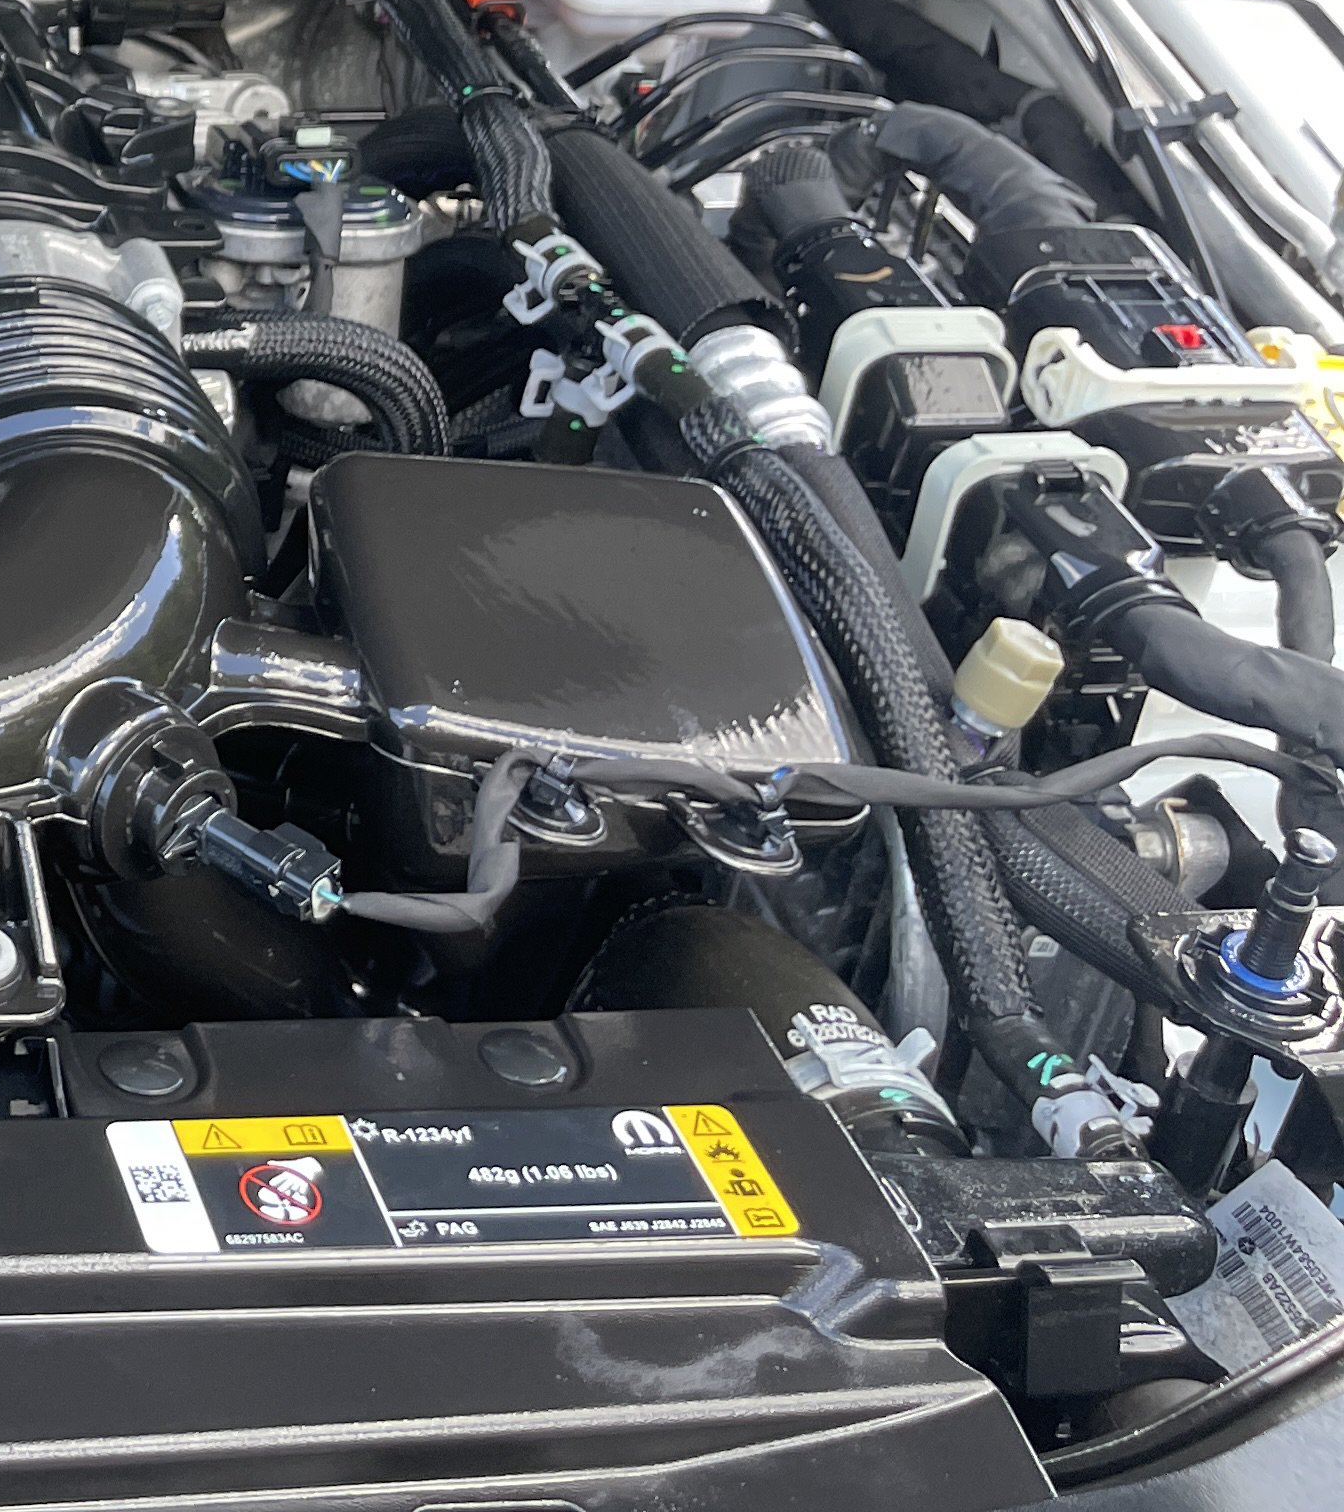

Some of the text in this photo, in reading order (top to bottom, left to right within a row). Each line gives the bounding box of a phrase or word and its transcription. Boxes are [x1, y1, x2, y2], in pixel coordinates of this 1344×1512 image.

[809, 1004, 858, 1023] RAD
[381, 1125, 473, 1145] R-1234yf
[468, 1163, 618, 1184] 482g (1.06 lbs)
[436, 1222, 479, 1236] PAG
[588, 1220, 618, 1232] SAE
[1259, 1205, 1340, 1308] WE0584W1004
